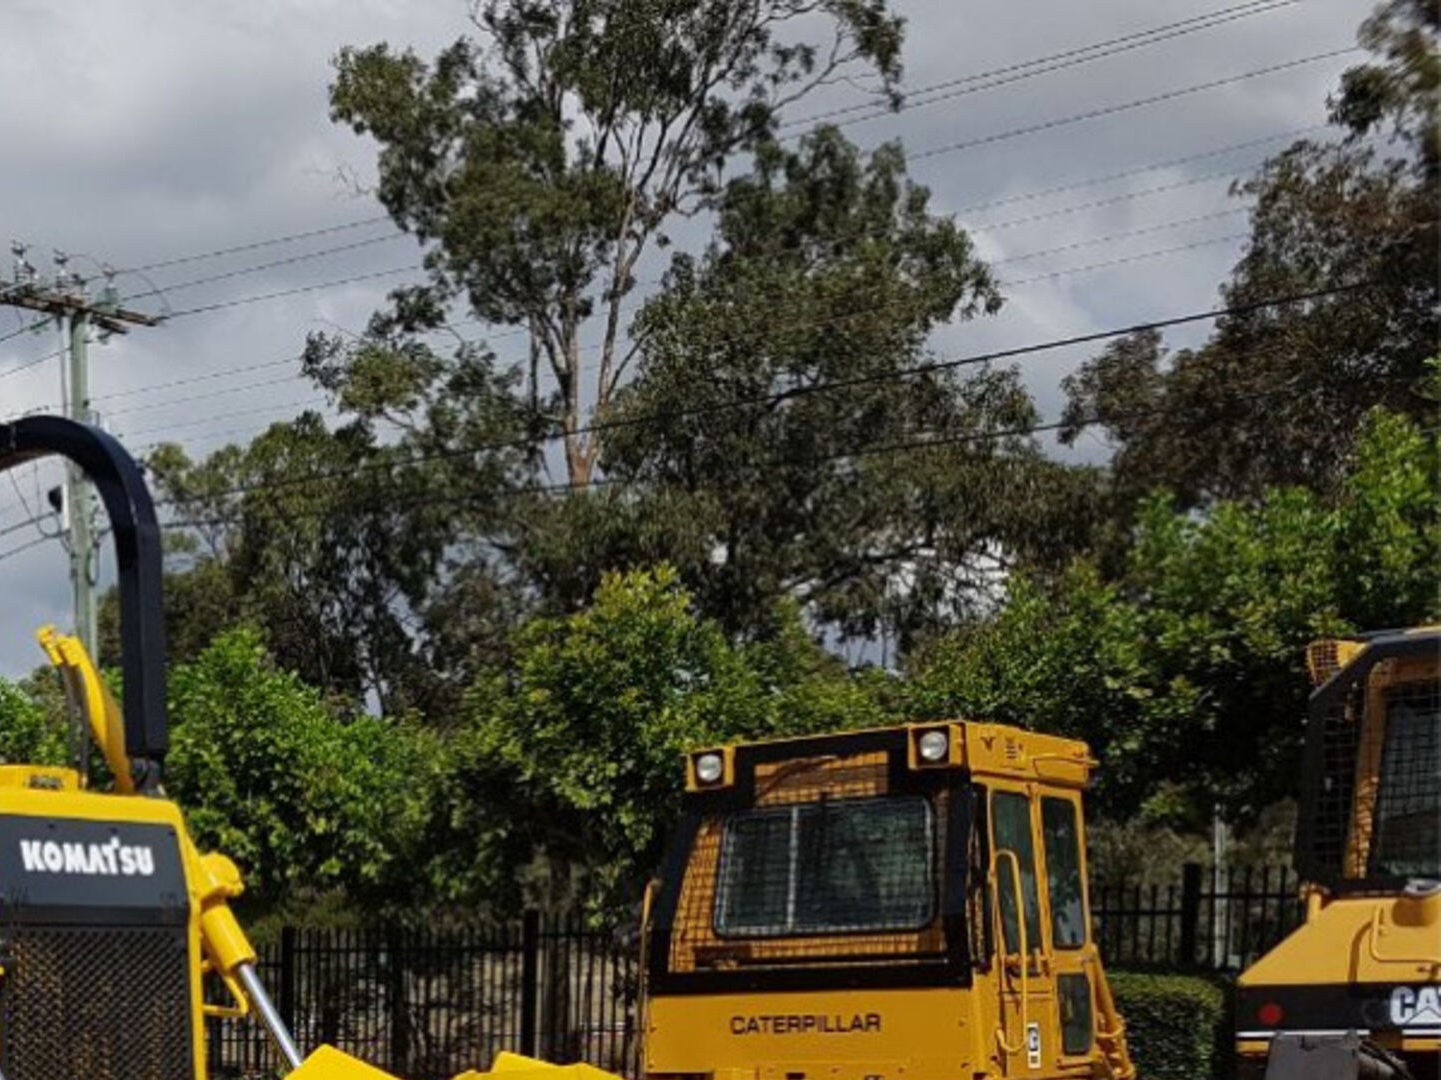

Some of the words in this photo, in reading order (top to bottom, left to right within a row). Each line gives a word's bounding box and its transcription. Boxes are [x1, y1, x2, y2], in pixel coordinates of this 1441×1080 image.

[20, 836, 155, 875] KOMATSU
[730, 1013, 882, 1035] CATERPILLAR
[1390, 986, 1441, 1026] CA
